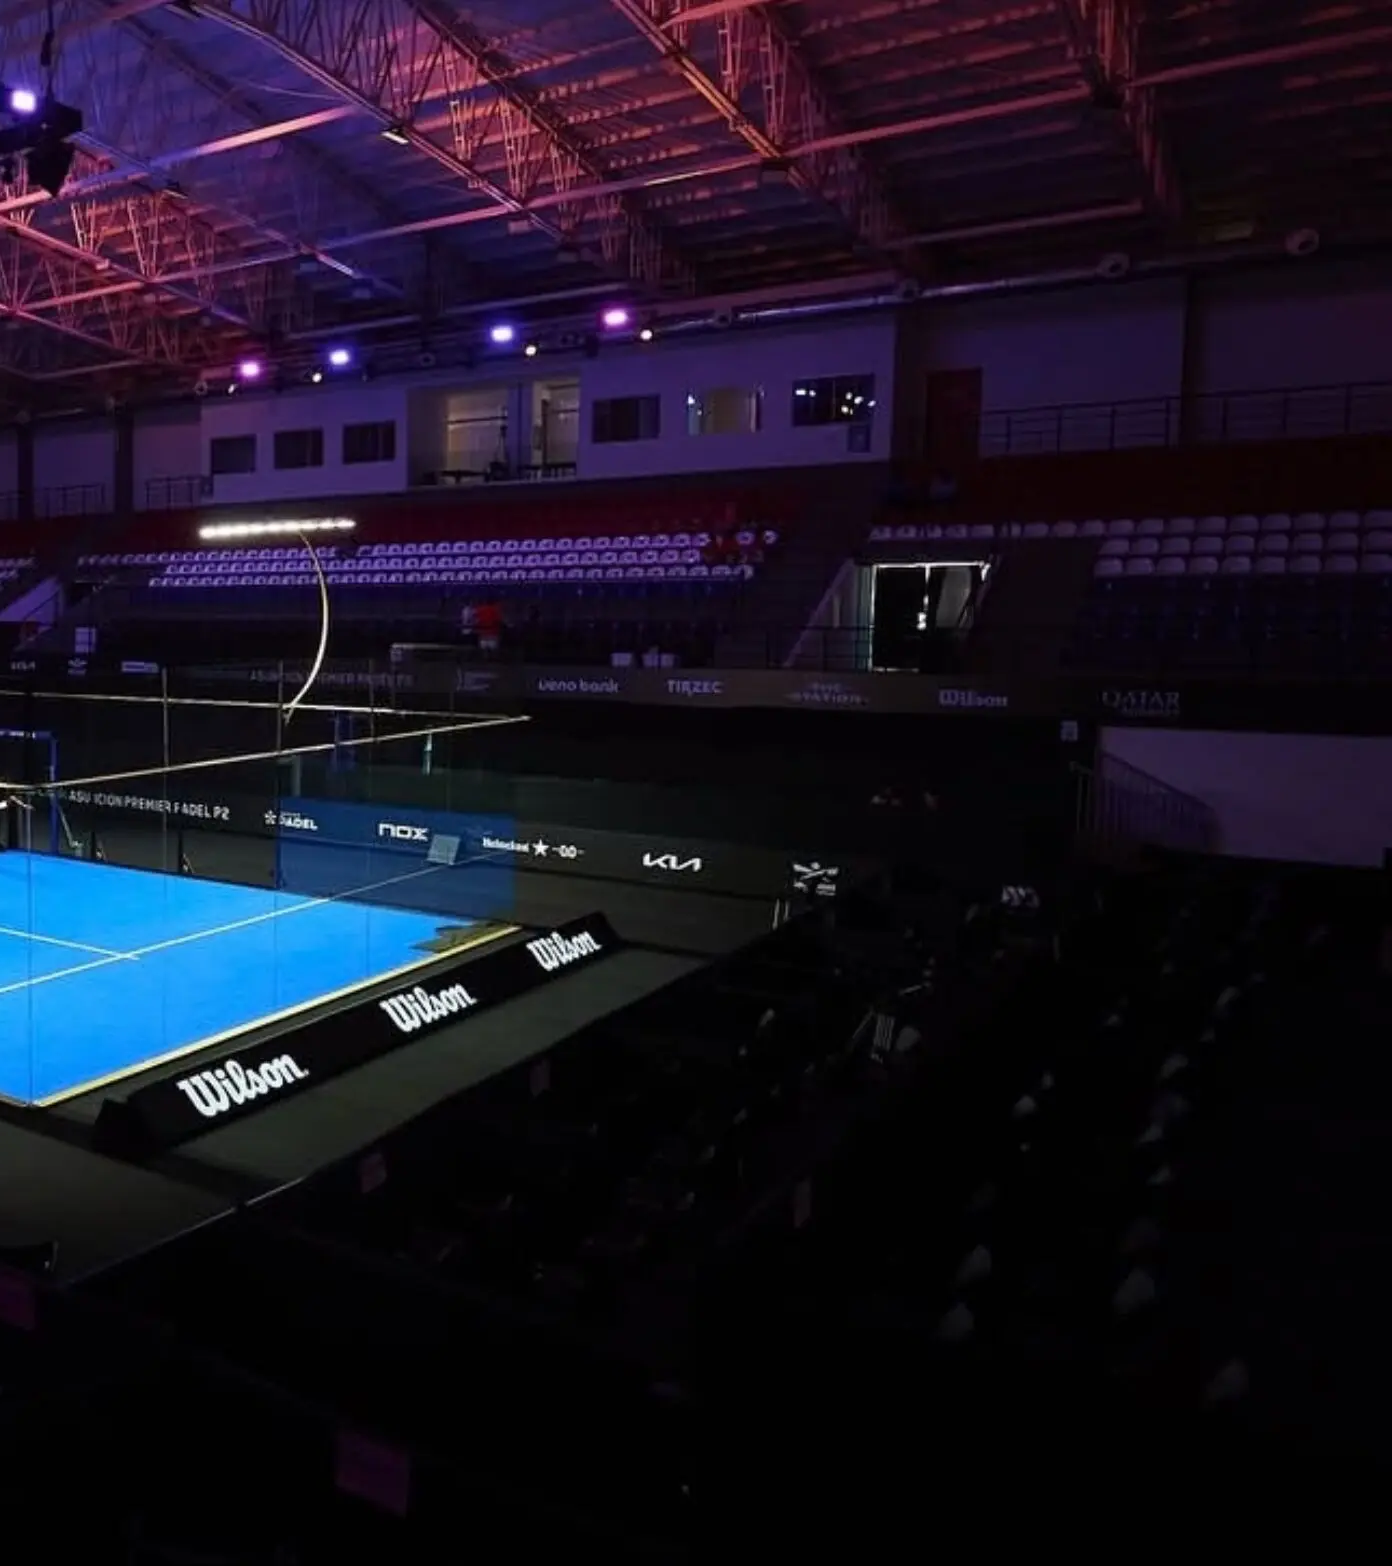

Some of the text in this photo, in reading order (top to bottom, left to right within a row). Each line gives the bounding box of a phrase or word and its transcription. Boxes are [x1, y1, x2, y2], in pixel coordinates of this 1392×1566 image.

[938, 687, 1008, 708] Wilson
[526, 928, 602, 972] Wilson
[379, 981, 477, 1033] Wilson
[176, 1053, 309, 1117] Wilson
